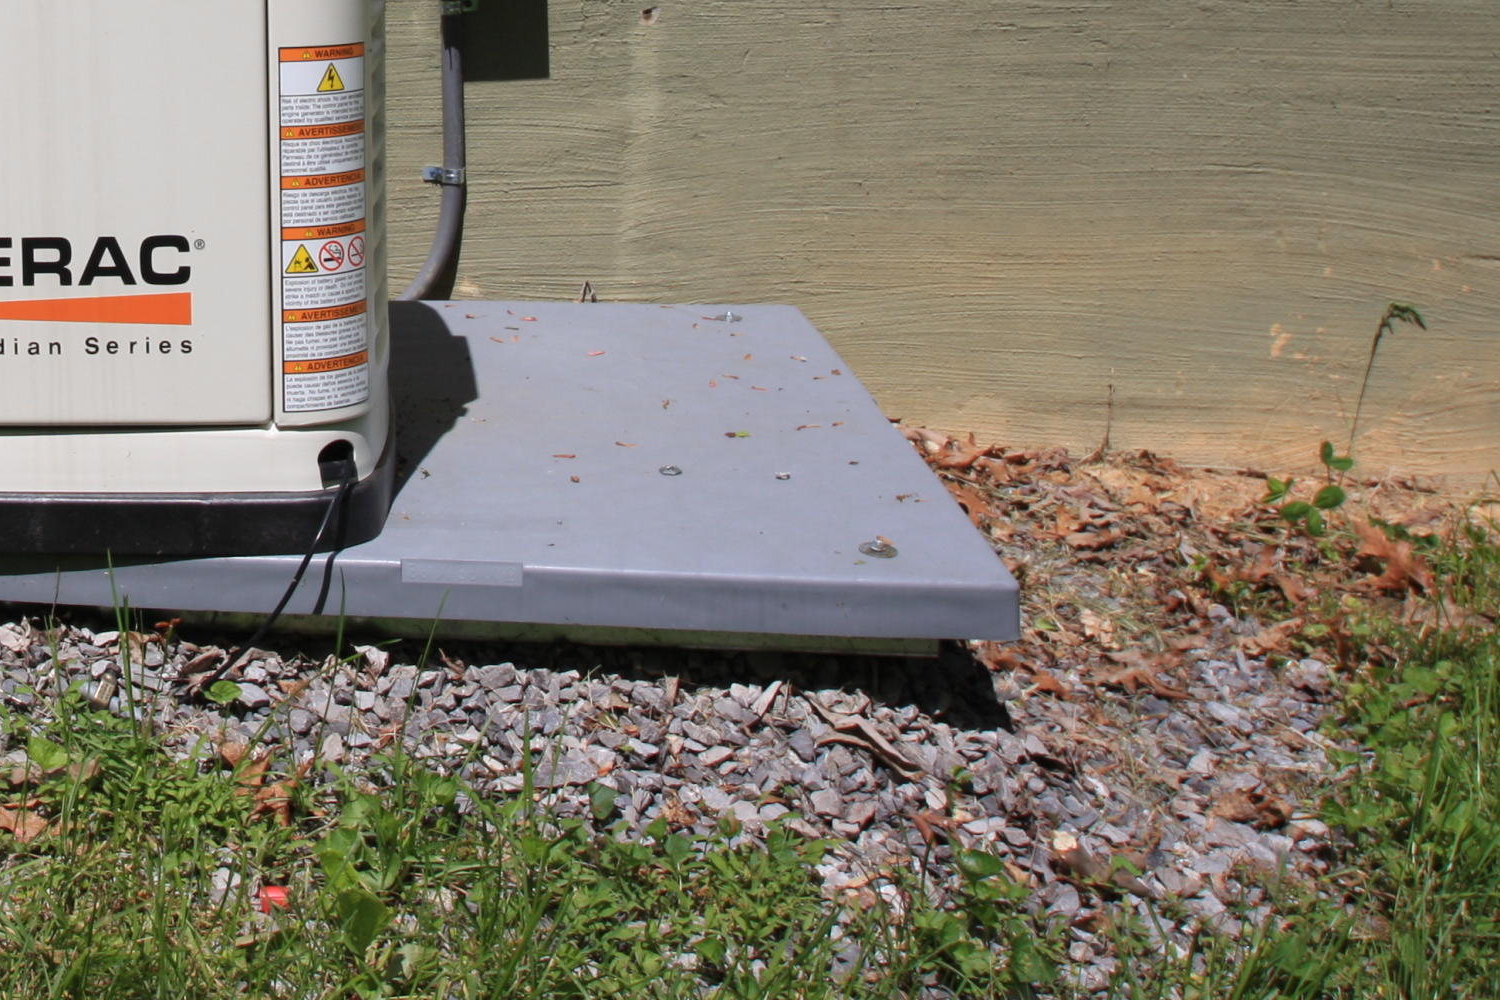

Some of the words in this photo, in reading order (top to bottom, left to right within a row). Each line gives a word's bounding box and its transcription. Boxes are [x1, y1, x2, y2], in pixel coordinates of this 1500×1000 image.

[314, 47, 354, 58] WARNING
[298, 123, 364, 137] AVERTISSEME
[316, 223, 356, 236] WARNING
[301, 303, 366, 320] AVERTISSEMEN
[84, 336, 194, 355] Series
